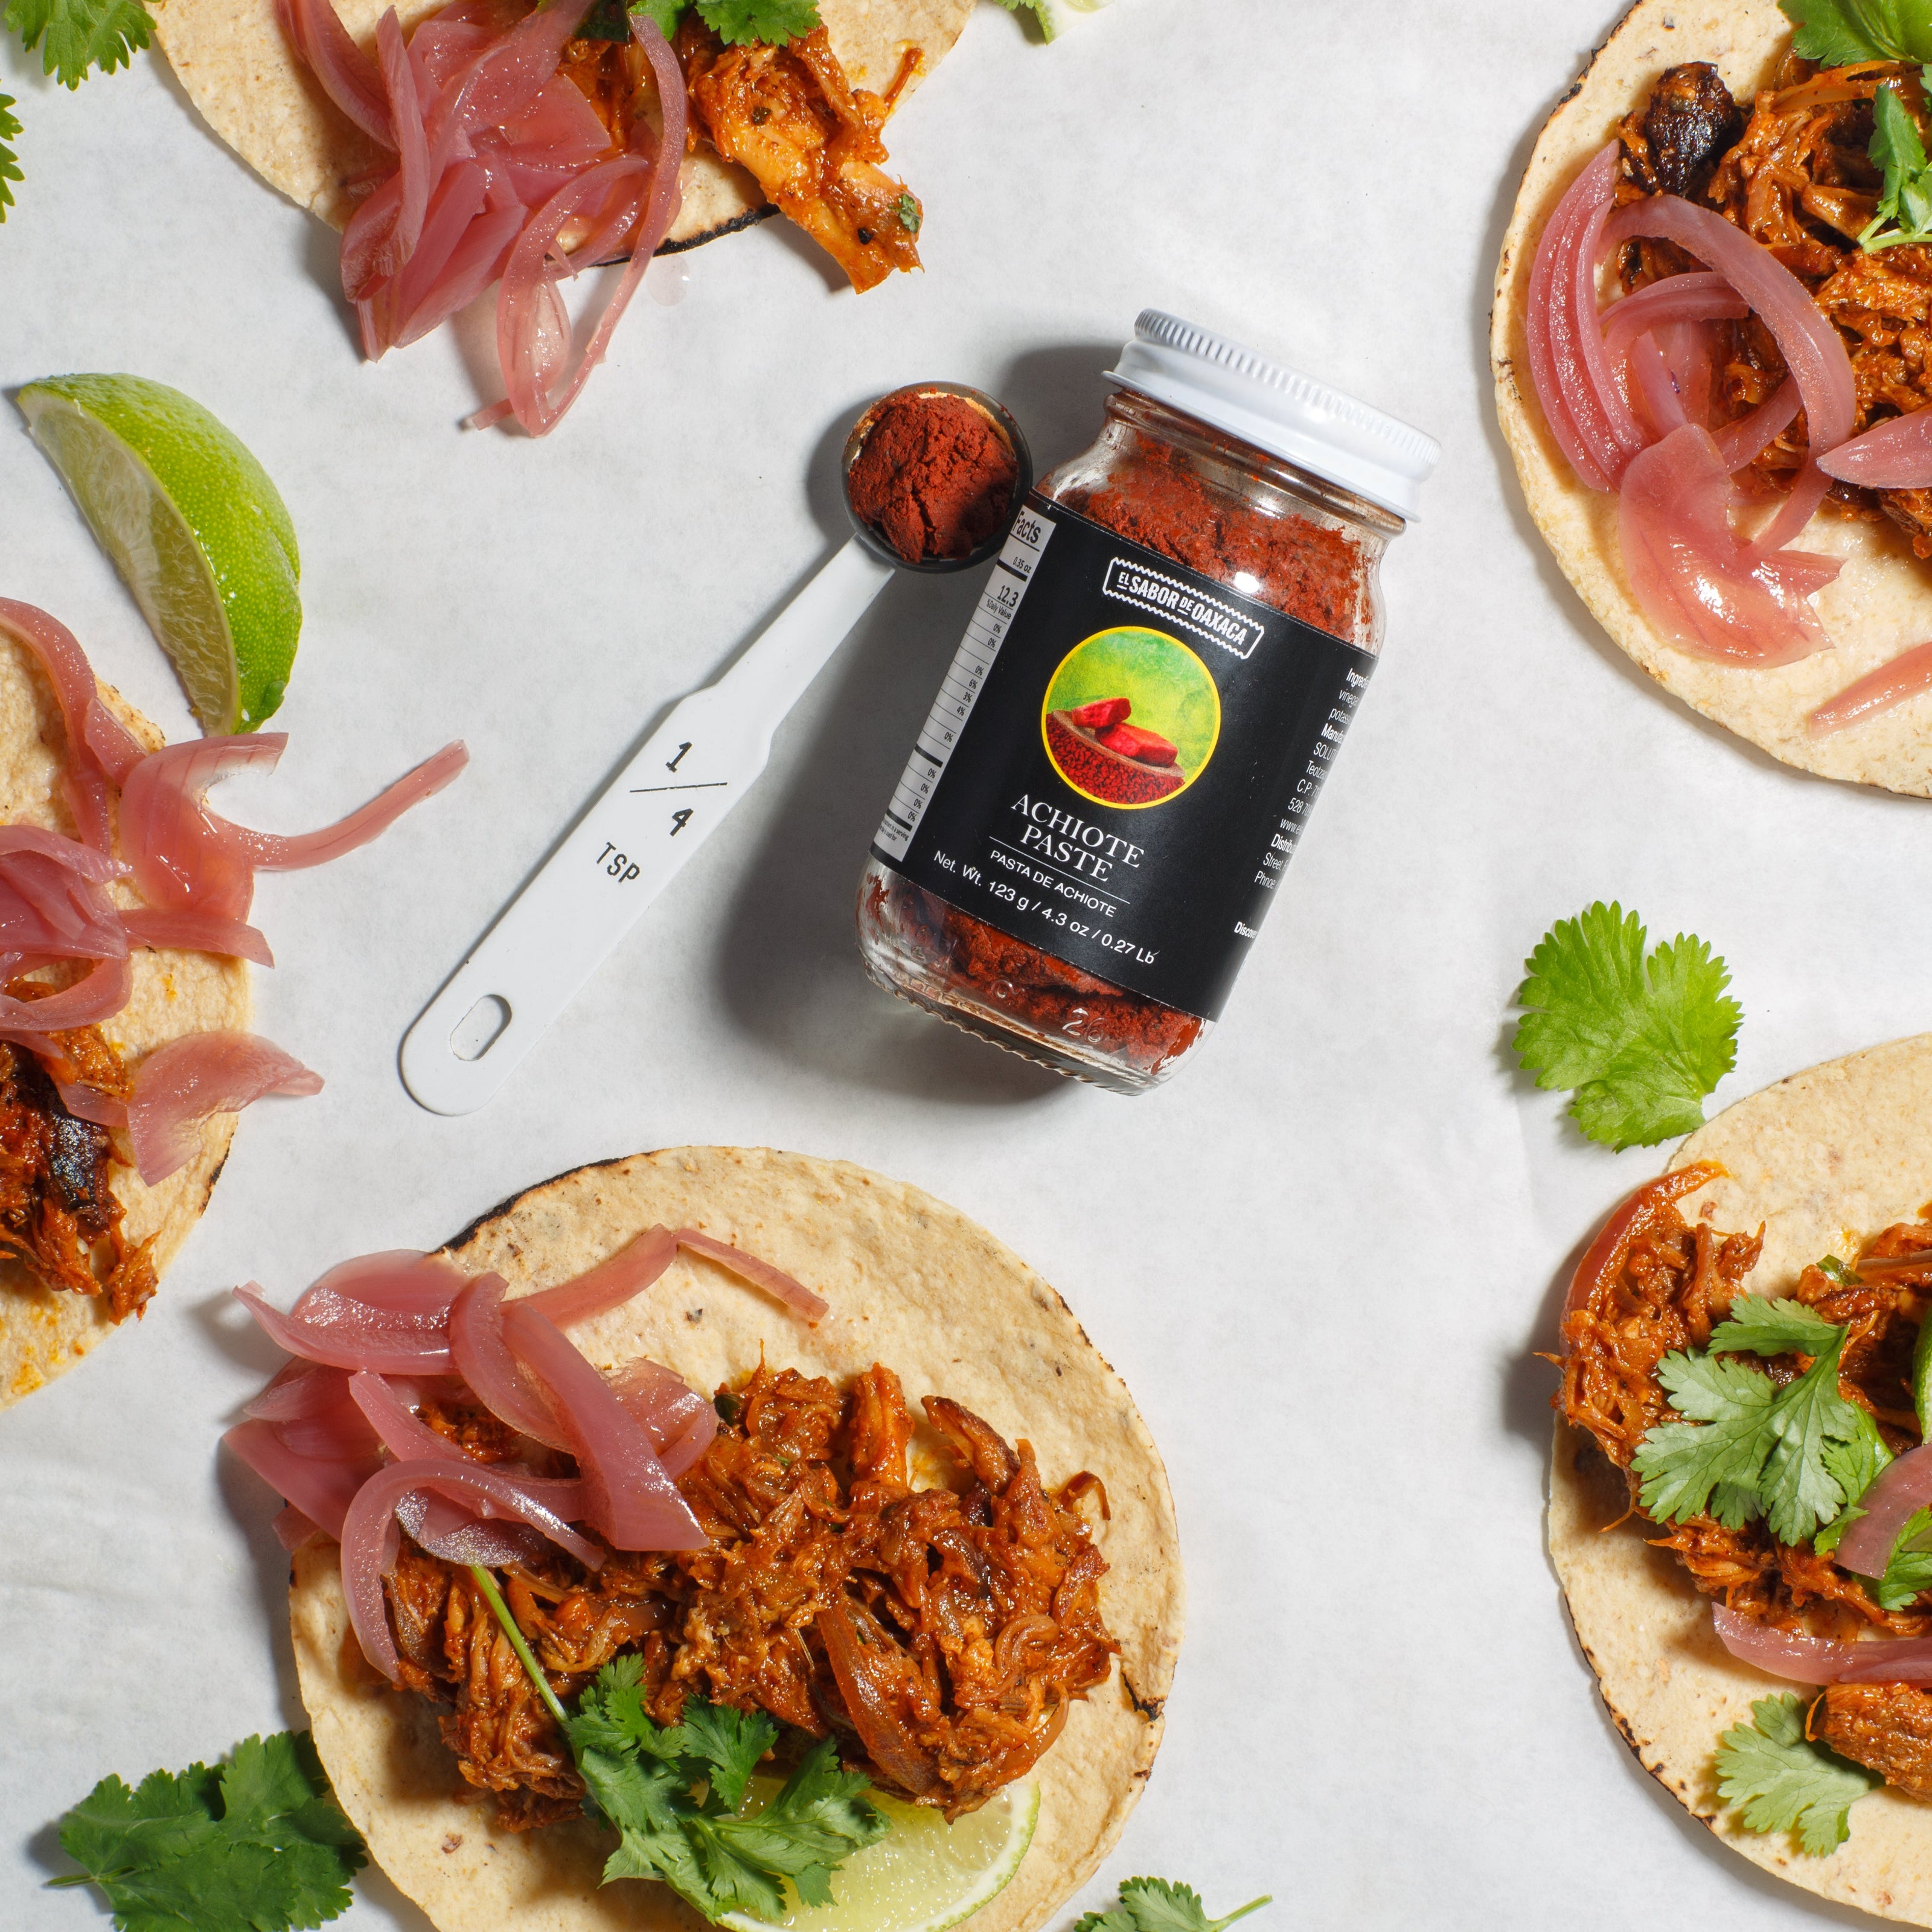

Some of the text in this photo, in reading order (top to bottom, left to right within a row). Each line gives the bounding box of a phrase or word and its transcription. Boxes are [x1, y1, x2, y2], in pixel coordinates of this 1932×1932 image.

[1012, 511, 1041, 544] Facts
[1012, 556, 1032, 574] 0.35 oz
[997, 584, 1019, 607] 12.3
[998, 606, 1012, 619] Value
[1118, 571, 1248, 645] EL SABOR DE OAXACA
[993, 623, 1002, 634] 0%
[987, 638, 997, 648] 0%
[975, 665, 984, 676] 0%
[969, 679, 978, 689] 6%
[963, 692, 973, 703] 3%
[956, 706, 966, 716] 4%
[944, 732, 954, 743] 0%
[665, 741, 693, 773] 1
[927, 768, 937, 779] 0%
[921, 783, 930, 794] 0%
[913, 799, 923, 809] 0%
[1288, 797, 1304, 813] 528
[670, 808, 694, 837] 4
[907, 811, 917, 822] 0%
[1011, 794, 1145, 868] ACHIOTE
[1020, 824, 1113, 882] PASTE
[597, 842, 641, 883] TSP
[991, 850, 1117, 918] PASTA DE ACHIOTE
[933, 850, 956, 873] Net.
[962, 864, 982, 886] Wt.
[989, 881, 1016, 901] 123
[1017, 897, 1029, 911] g
[1041, 908, 1067, 926] 4.3
[1070, 921, 1090, 936] oz
[1101, 933, 1136, 955] 0.27
[1136, 947, 1155, 964] Lb
